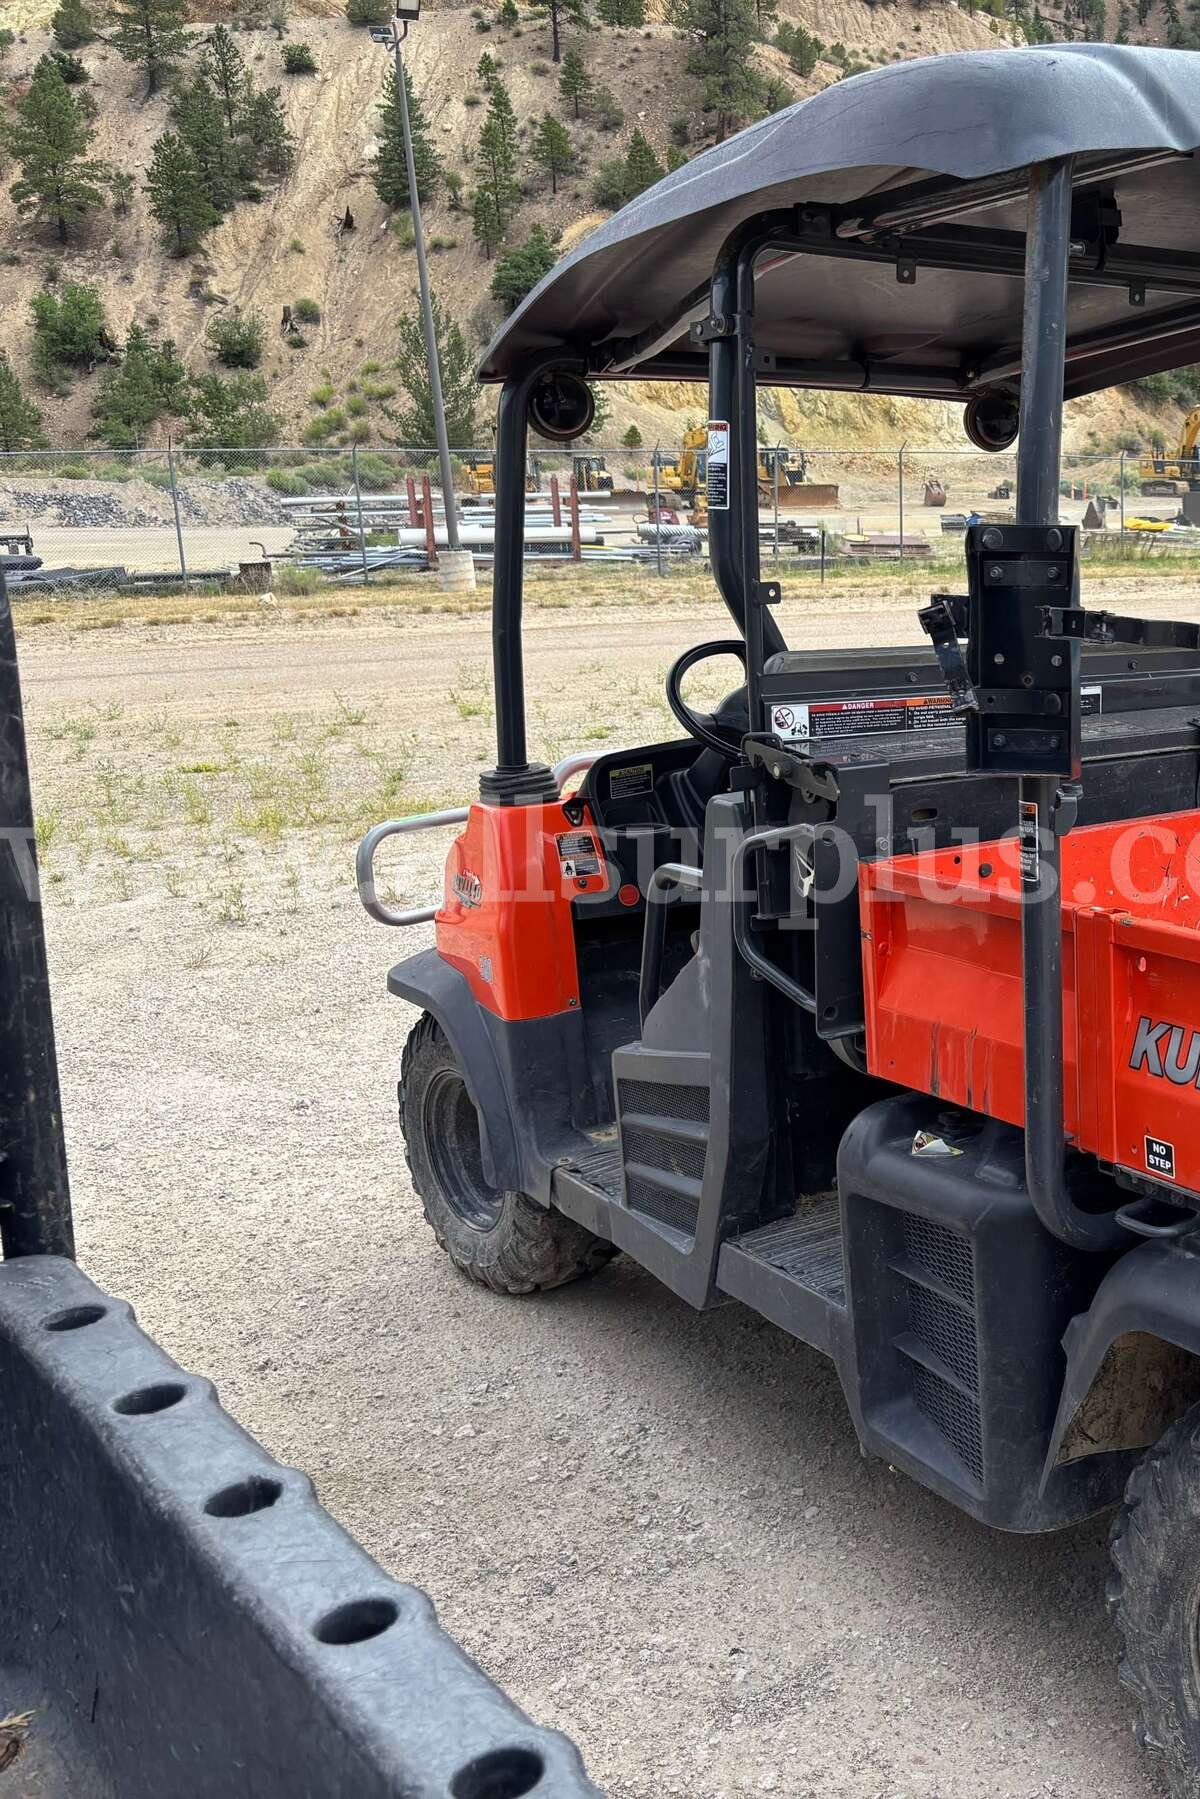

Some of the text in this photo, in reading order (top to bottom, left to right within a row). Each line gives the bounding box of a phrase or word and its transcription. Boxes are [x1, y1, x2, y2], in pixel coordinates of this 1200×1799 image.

[848, 702, 874, 710] DANGER
[1152, 1142, 1166, 1155] NO
[1148, 1154, 1171, 1169] STEP
